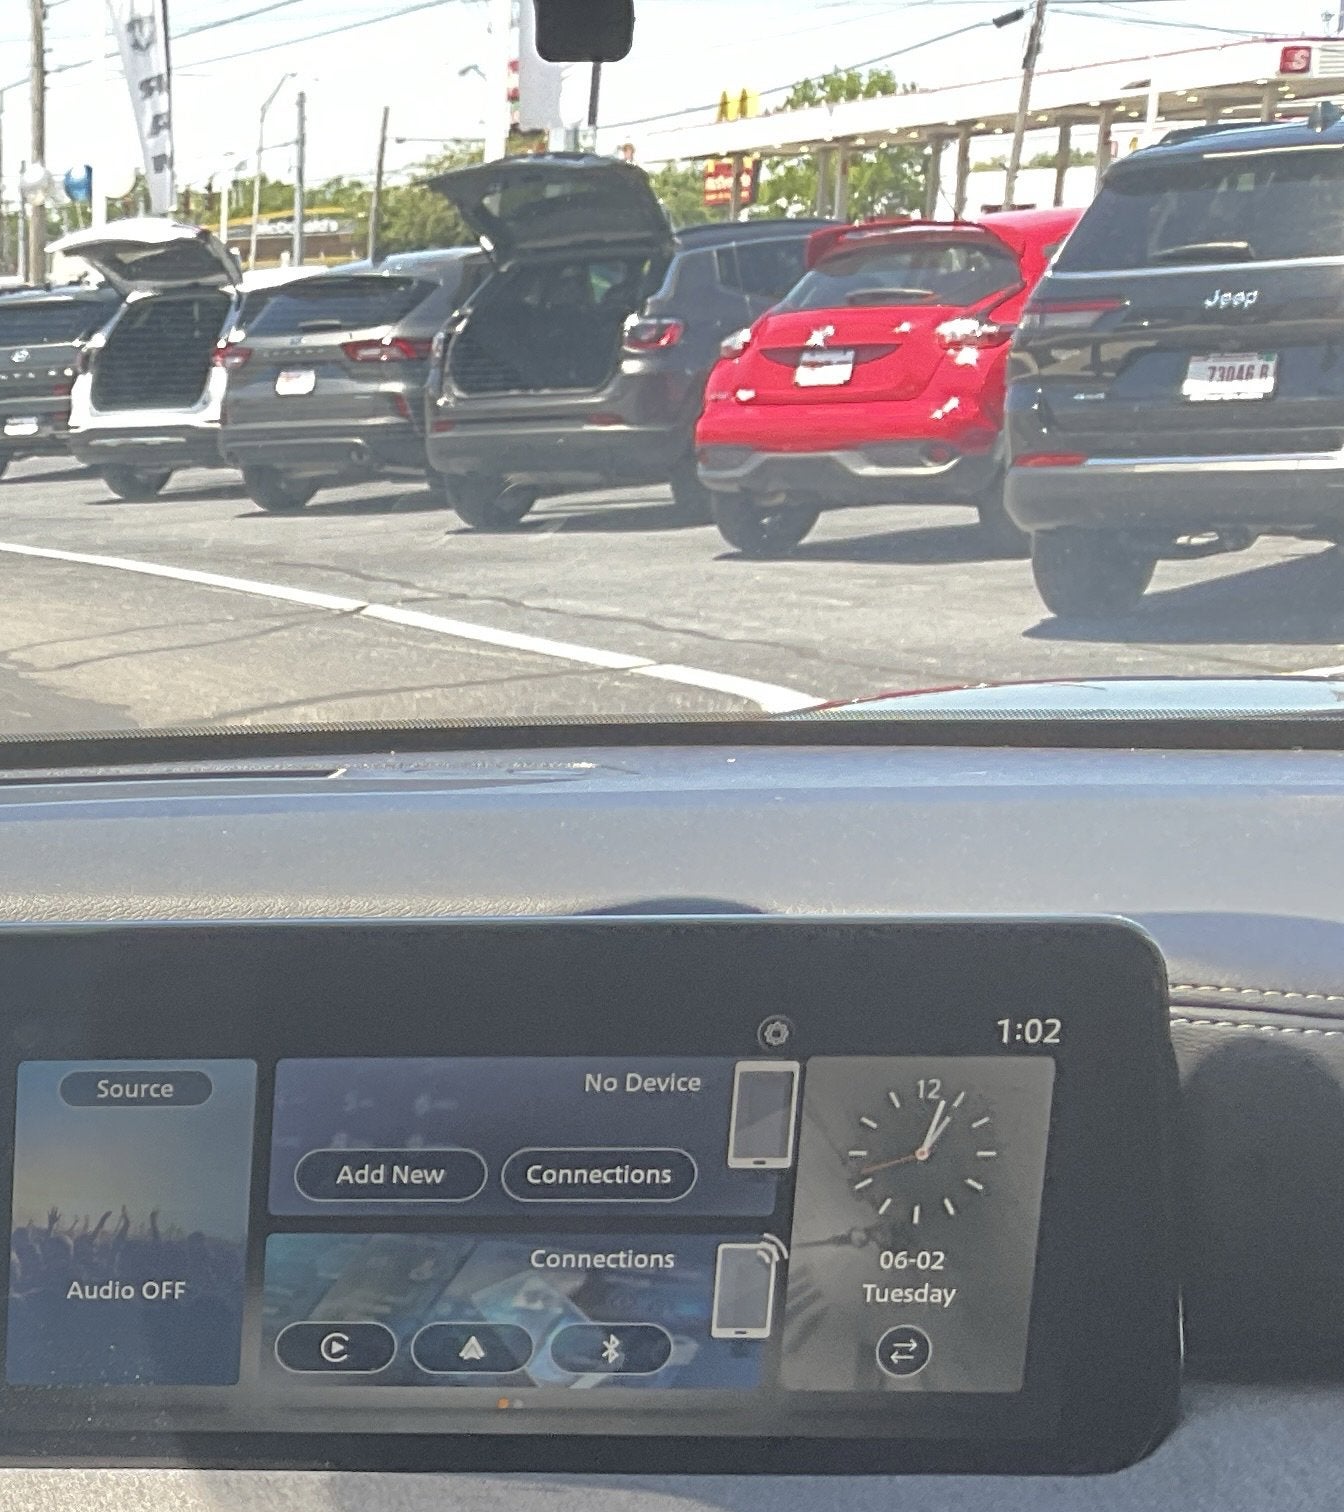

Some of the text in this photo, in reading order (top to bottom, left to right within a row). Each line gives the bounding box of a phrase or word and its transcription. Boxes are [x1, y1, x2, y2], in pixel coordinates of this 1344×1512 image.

[1203, 288, 1258, 310] Jeep
[998, 1018, 1062, 1044] 1:02
[96, 1078, 174, 1100] Source
[584, 1072, 701, 1093] No Device
[917, 1079, 941, 1099] 12
[336, 1163, 445, 1186] Add New
[526, 1164, 672, 1186] Connections
[530, 1249, 675, 1270] Connections
[879, 1251, 945, 1271] 06-02
[66, 1280, 186, 1301] Audio OFF
[863, 1283, 956, 1308] Tuesday
